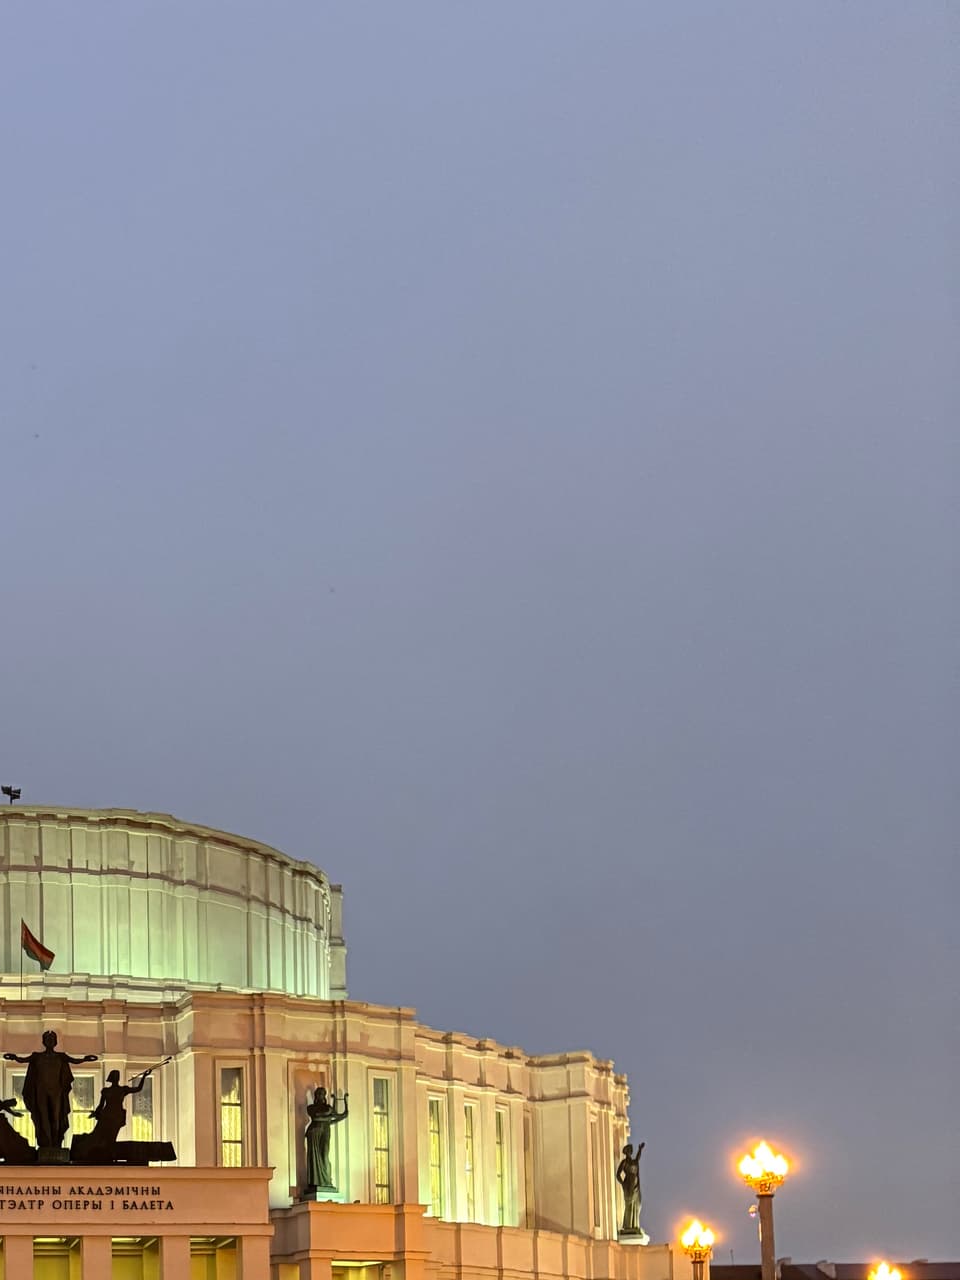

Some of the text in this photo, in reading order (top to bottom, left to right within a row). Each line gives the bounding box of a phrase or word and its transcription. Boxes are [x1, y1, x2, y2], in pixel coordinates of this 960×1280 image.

[69, 1185, 161, 1195] АКАДЭМІЧНЫ
[52, 1199, 102, 1210] ОПЕРЫ
[122, 1199, 174, 1210] БАЛЕТА
